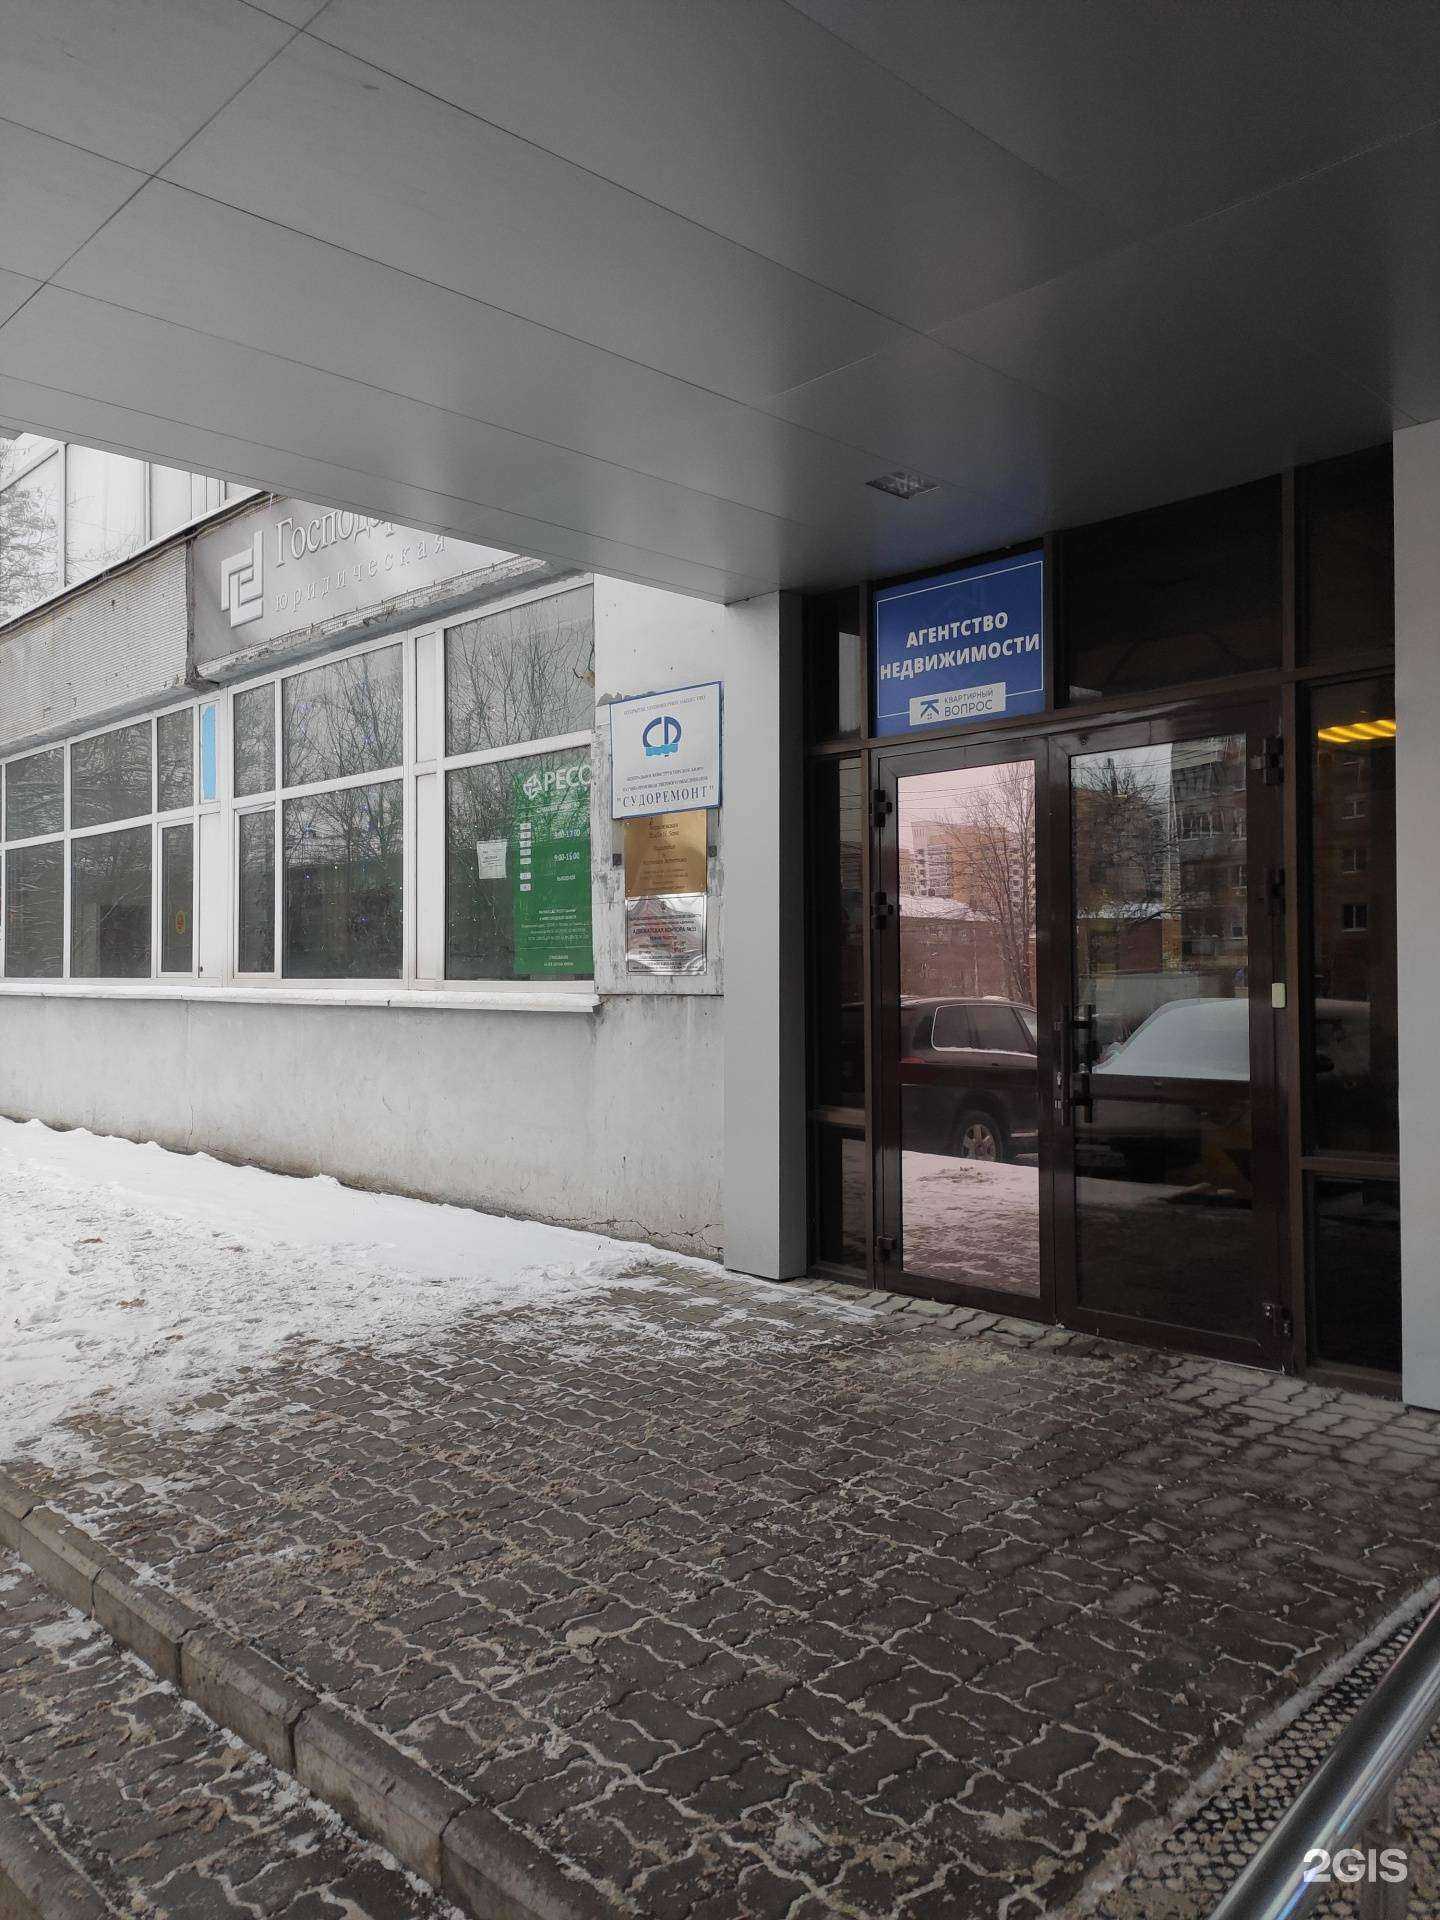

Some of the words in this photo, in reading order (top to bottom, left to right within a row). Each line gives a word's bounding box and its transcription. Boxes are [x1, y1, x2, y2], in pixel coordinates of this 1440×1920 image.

[274, 535, 447, 613] юридическая
[905, 611, 1008, 649] АГЕНТСТВО
[880, 633, 1040, 681] НЕДВИЖИМОСТИ
[944, 687, 994, 704] КВАРТИРНЫЙ
[944, 699, 993, 717] ВОПРОС
